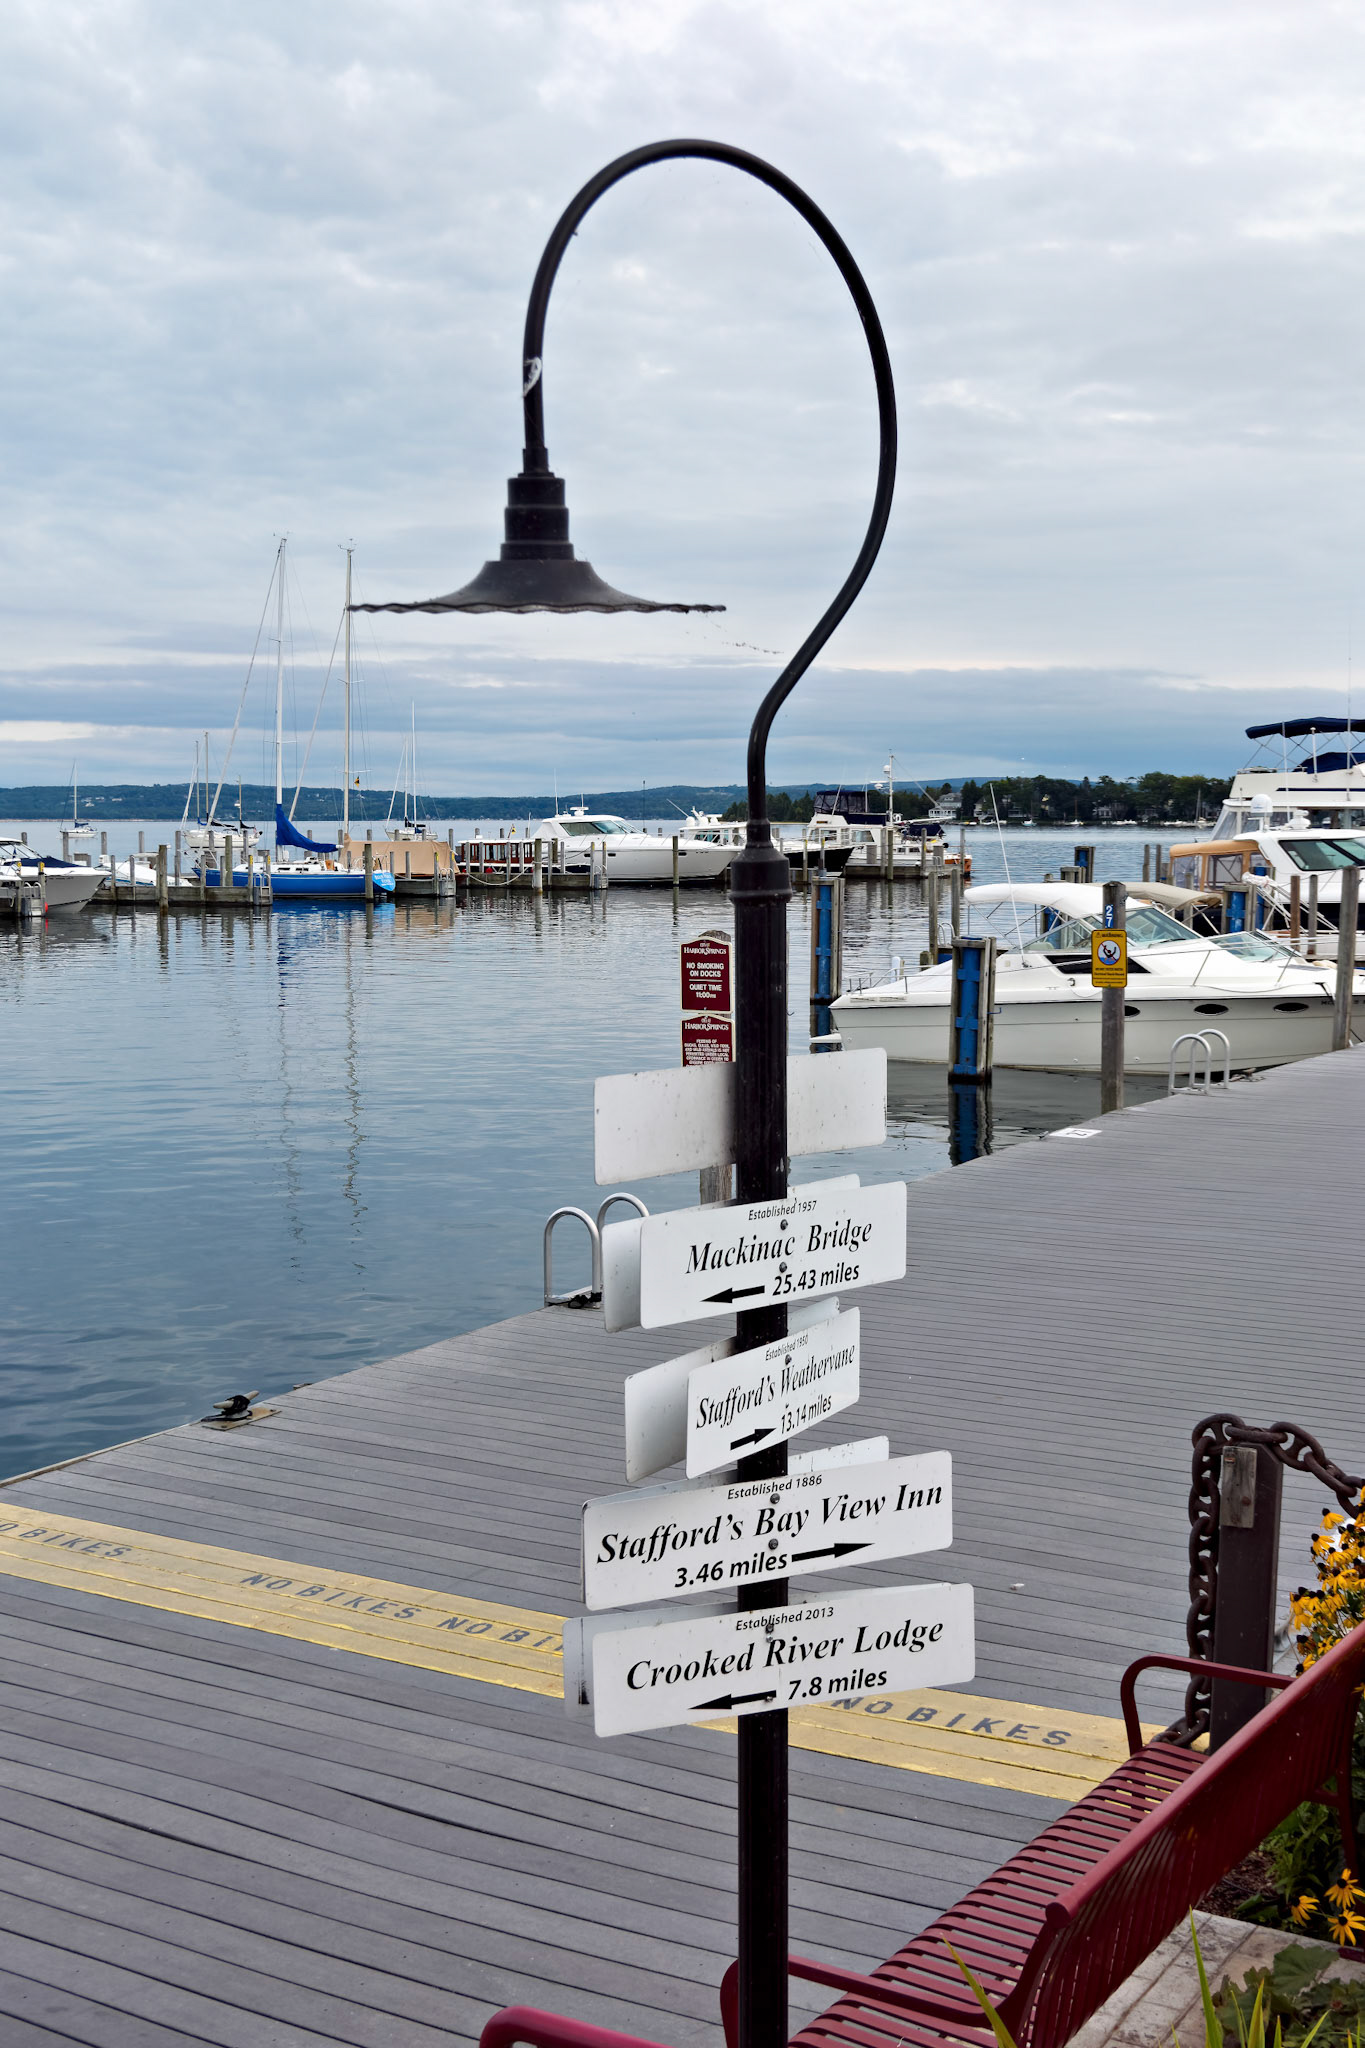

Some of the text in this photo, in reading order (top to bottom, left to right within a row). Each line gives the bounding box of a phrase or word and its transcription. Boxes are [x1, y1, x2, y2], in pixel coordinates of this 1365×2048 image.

[1105, 904, 1113, 928] 27
[696, 962, 725, 970] SMOKING
[699, 970, 722, 978] DOCKS
[689, 983, 723, 992] QUIET TIME
[748, 1200, 817, 1221] Established 1957
[685, 1218, 873, 1274] Mackinac Bridge
[772, 1262, 860, 1296] 25.43 miles
[765, 1342, 796, 1361] Established
[695, 1345, 856, 1430] Stafford's Weathervane
[781, 1394, 832, 1434] 13.14 miles
[727, 1474, 823, 1500] Established 1886
[597, 1483, 943, 1565] Stafford's Bay View Inn
[18, 1528, 132, 1557] BIKES
[674, 1551, 788, 1588] 3.46 miles
[240, 1572, 424, 1620] NO BIKES
[436, 1616, 493, 1635] NO
[735, 1606, 835, 1632] Established 2013
[626, 1618, 945, 1691] Crooked River Lodge
[787, 1668, 888, 1701] 7.8 miles
[830, 1696, 1073, 1747] NO BIKES
